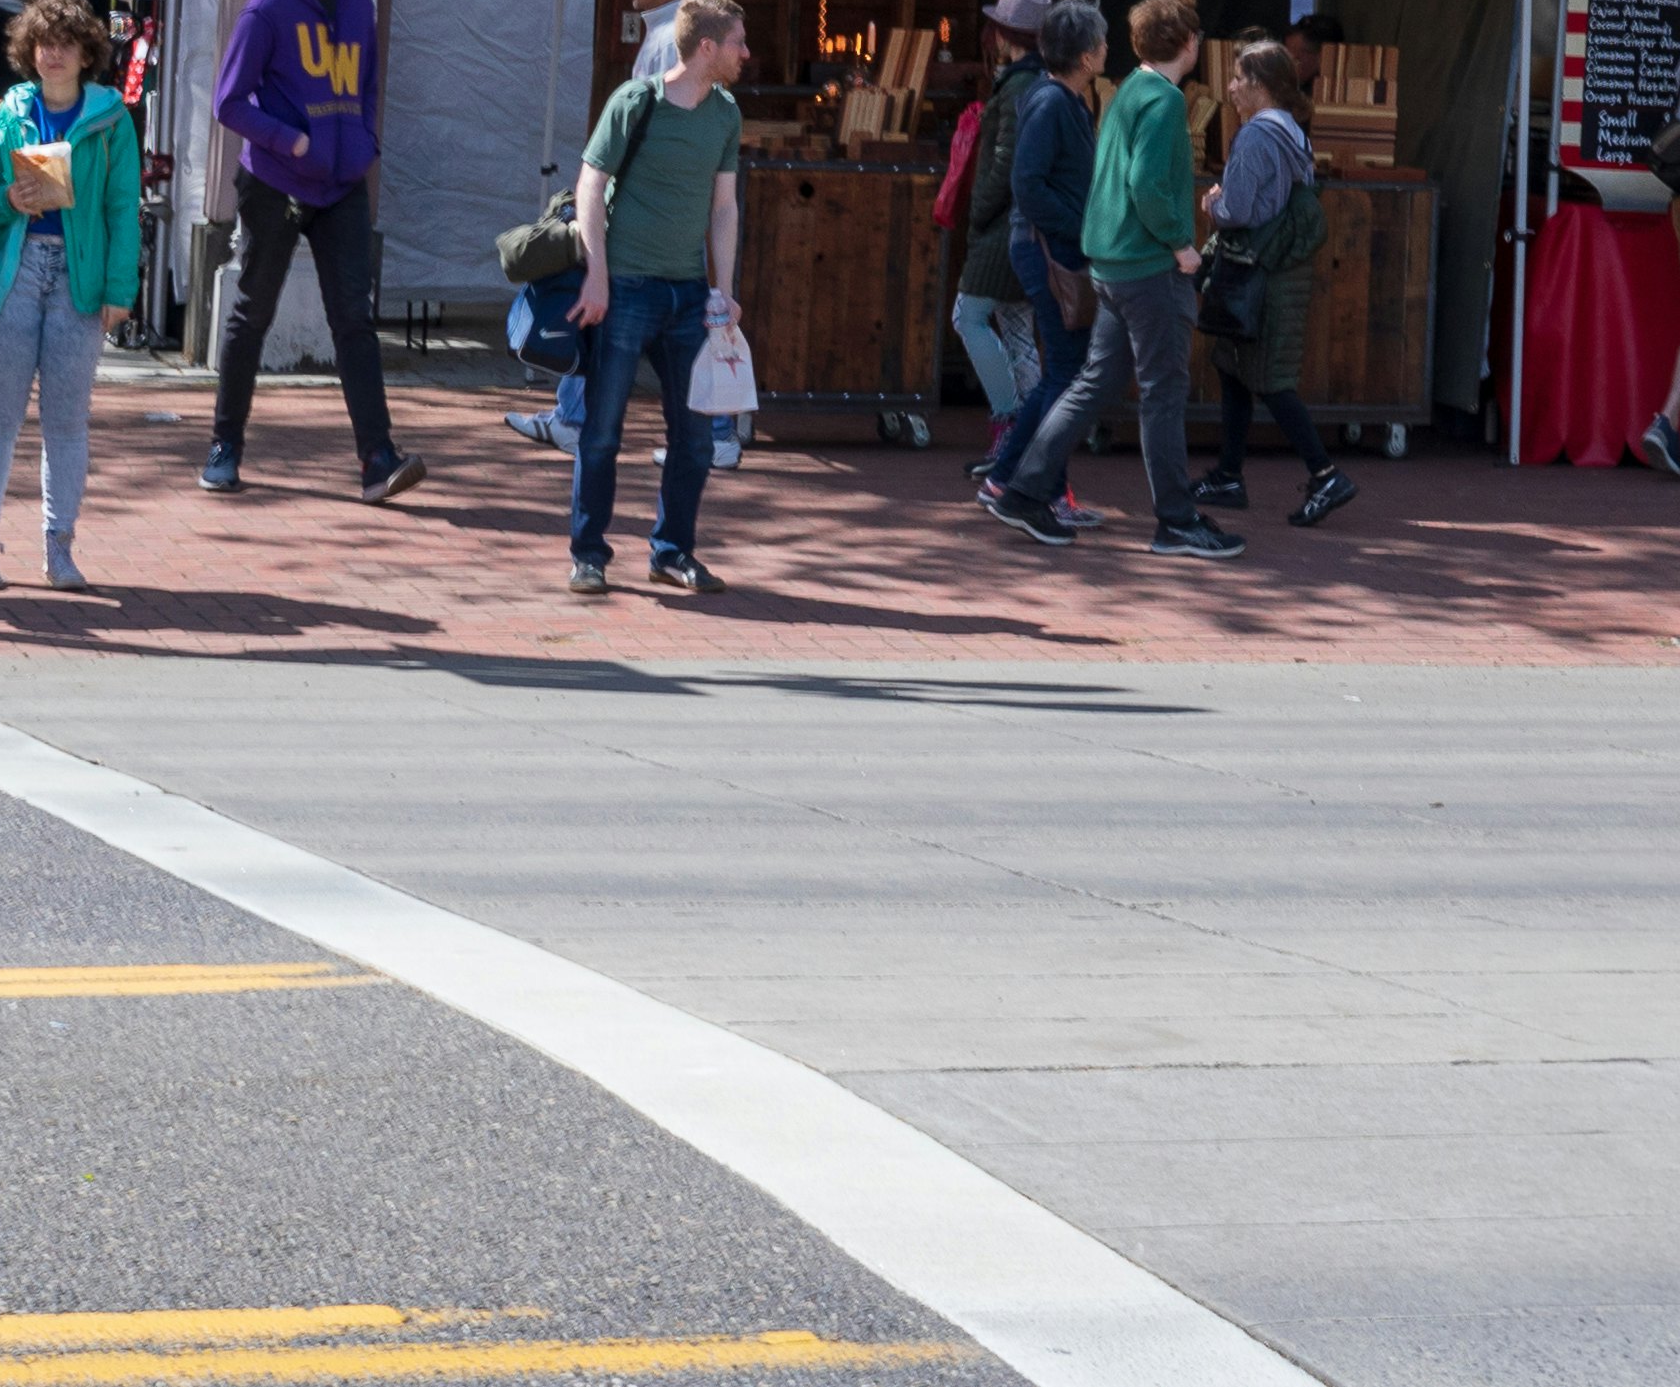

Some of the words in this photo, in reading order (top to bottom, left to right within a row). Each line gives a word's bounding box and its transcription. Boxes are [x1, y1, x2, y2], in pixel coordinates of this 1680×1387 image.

[1589, 3, 1620, 18] Cajun
[1589, 17, 1628, 31] Coconut
[295, 22, 362, 96] UW
[1587, 46, 1636, 62] Cinnamon
[1640, 49, 1674, 64] Pecans
[1586, 60, 1635, 76] Cinnamon
[1586, 74, 1635, 90] Cinnamon
[1585, 90, 1622, 106] Orange
[1598, 109, 1638, 128] Small
[1598, 129, 1652, 147] Medium
[1597, 149, 1633, 166] Large
